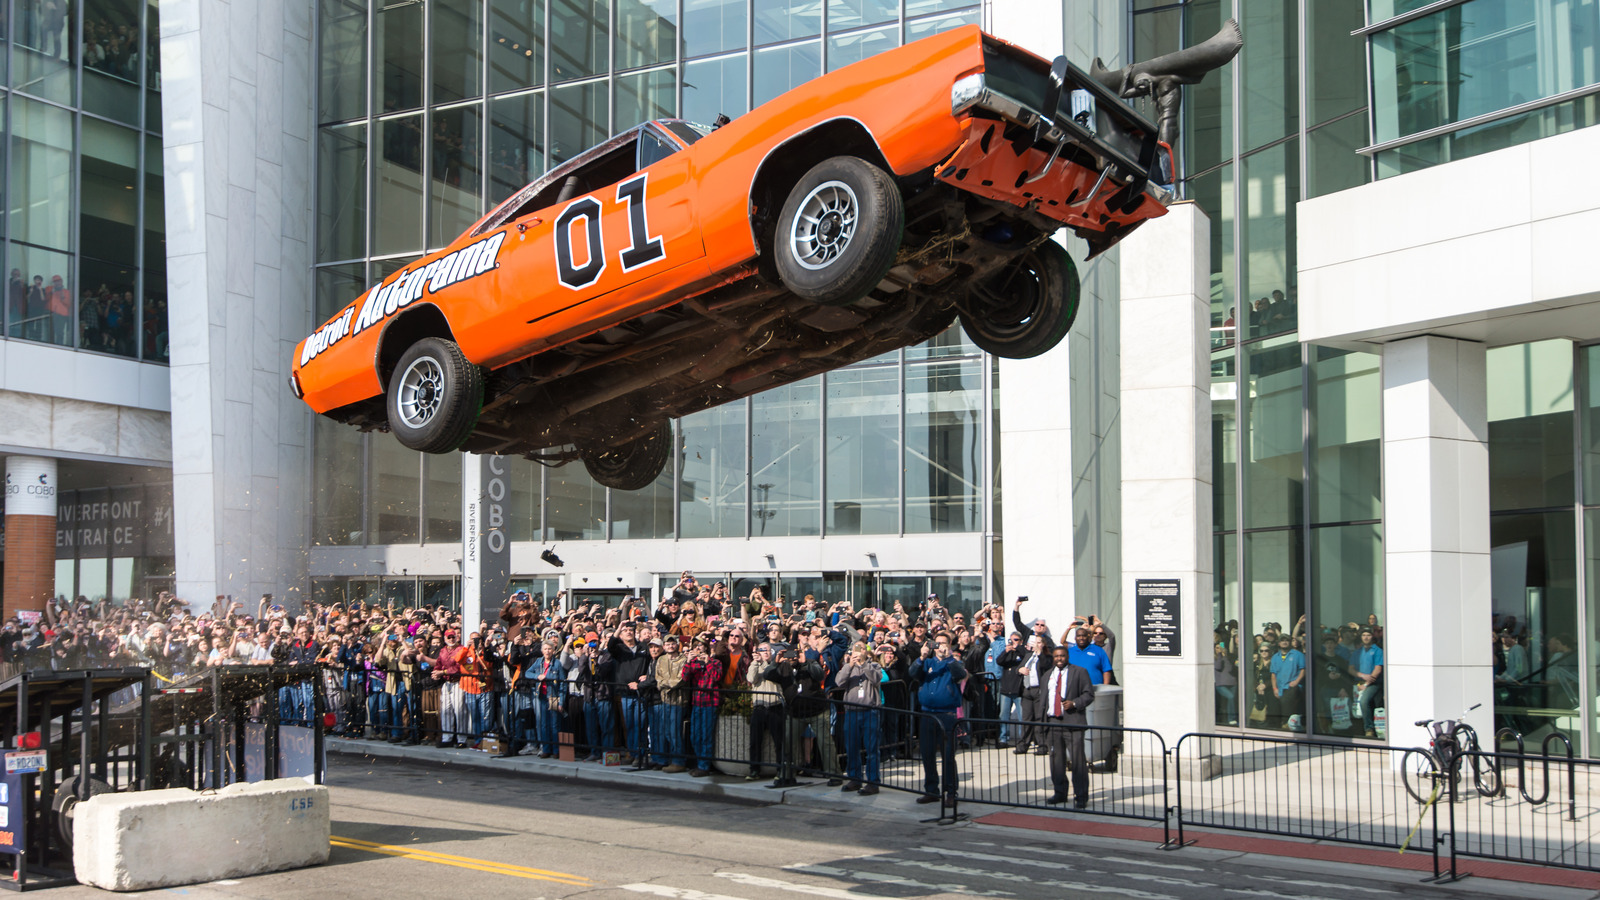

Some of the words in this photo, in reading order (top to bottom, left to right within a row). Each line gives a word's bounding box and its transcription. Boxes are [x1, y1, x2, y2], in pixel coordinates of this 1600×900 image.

[554, 173, 666, 291] 01
[300, 305, 356, 367] Detroit
[353, 230, 507, 337] Autorama
[27, 484, 55, 496] COBO
[154, 506, 172, 535] #1
[488, 455, 505, 554] COBO
